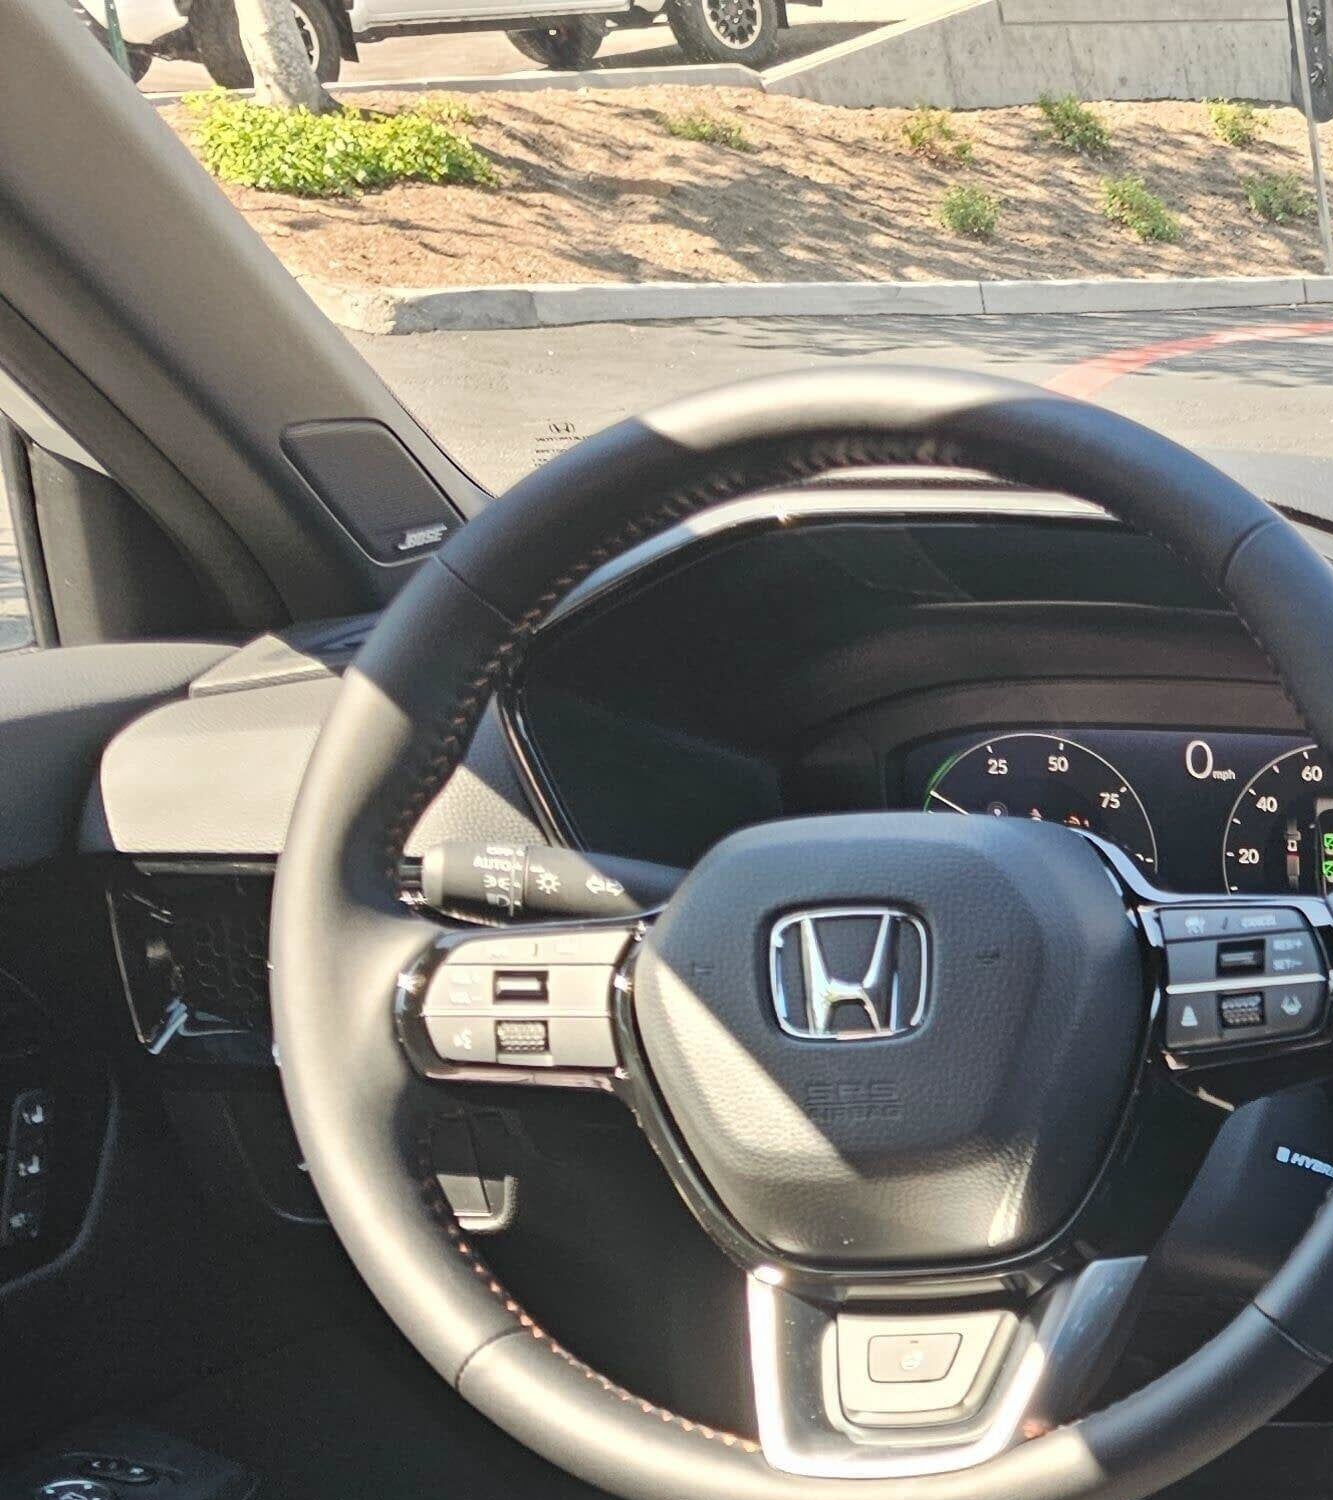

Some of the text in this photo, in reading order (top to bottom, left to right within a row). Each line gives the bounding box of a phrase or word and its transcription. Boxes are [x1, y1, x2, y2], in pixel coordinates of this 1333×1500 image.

[988, 759, 1008, 775] 25
[1048, 757, 1069, 773] 50
[1185, 740, 1236, 783] 0 mph
[1301, 765, 1323, 782] 60
[1100, 793, 1121, 810] 75
[1256, 797, 1278, 814] 40
[1238, 849, 1260, 865] 20
